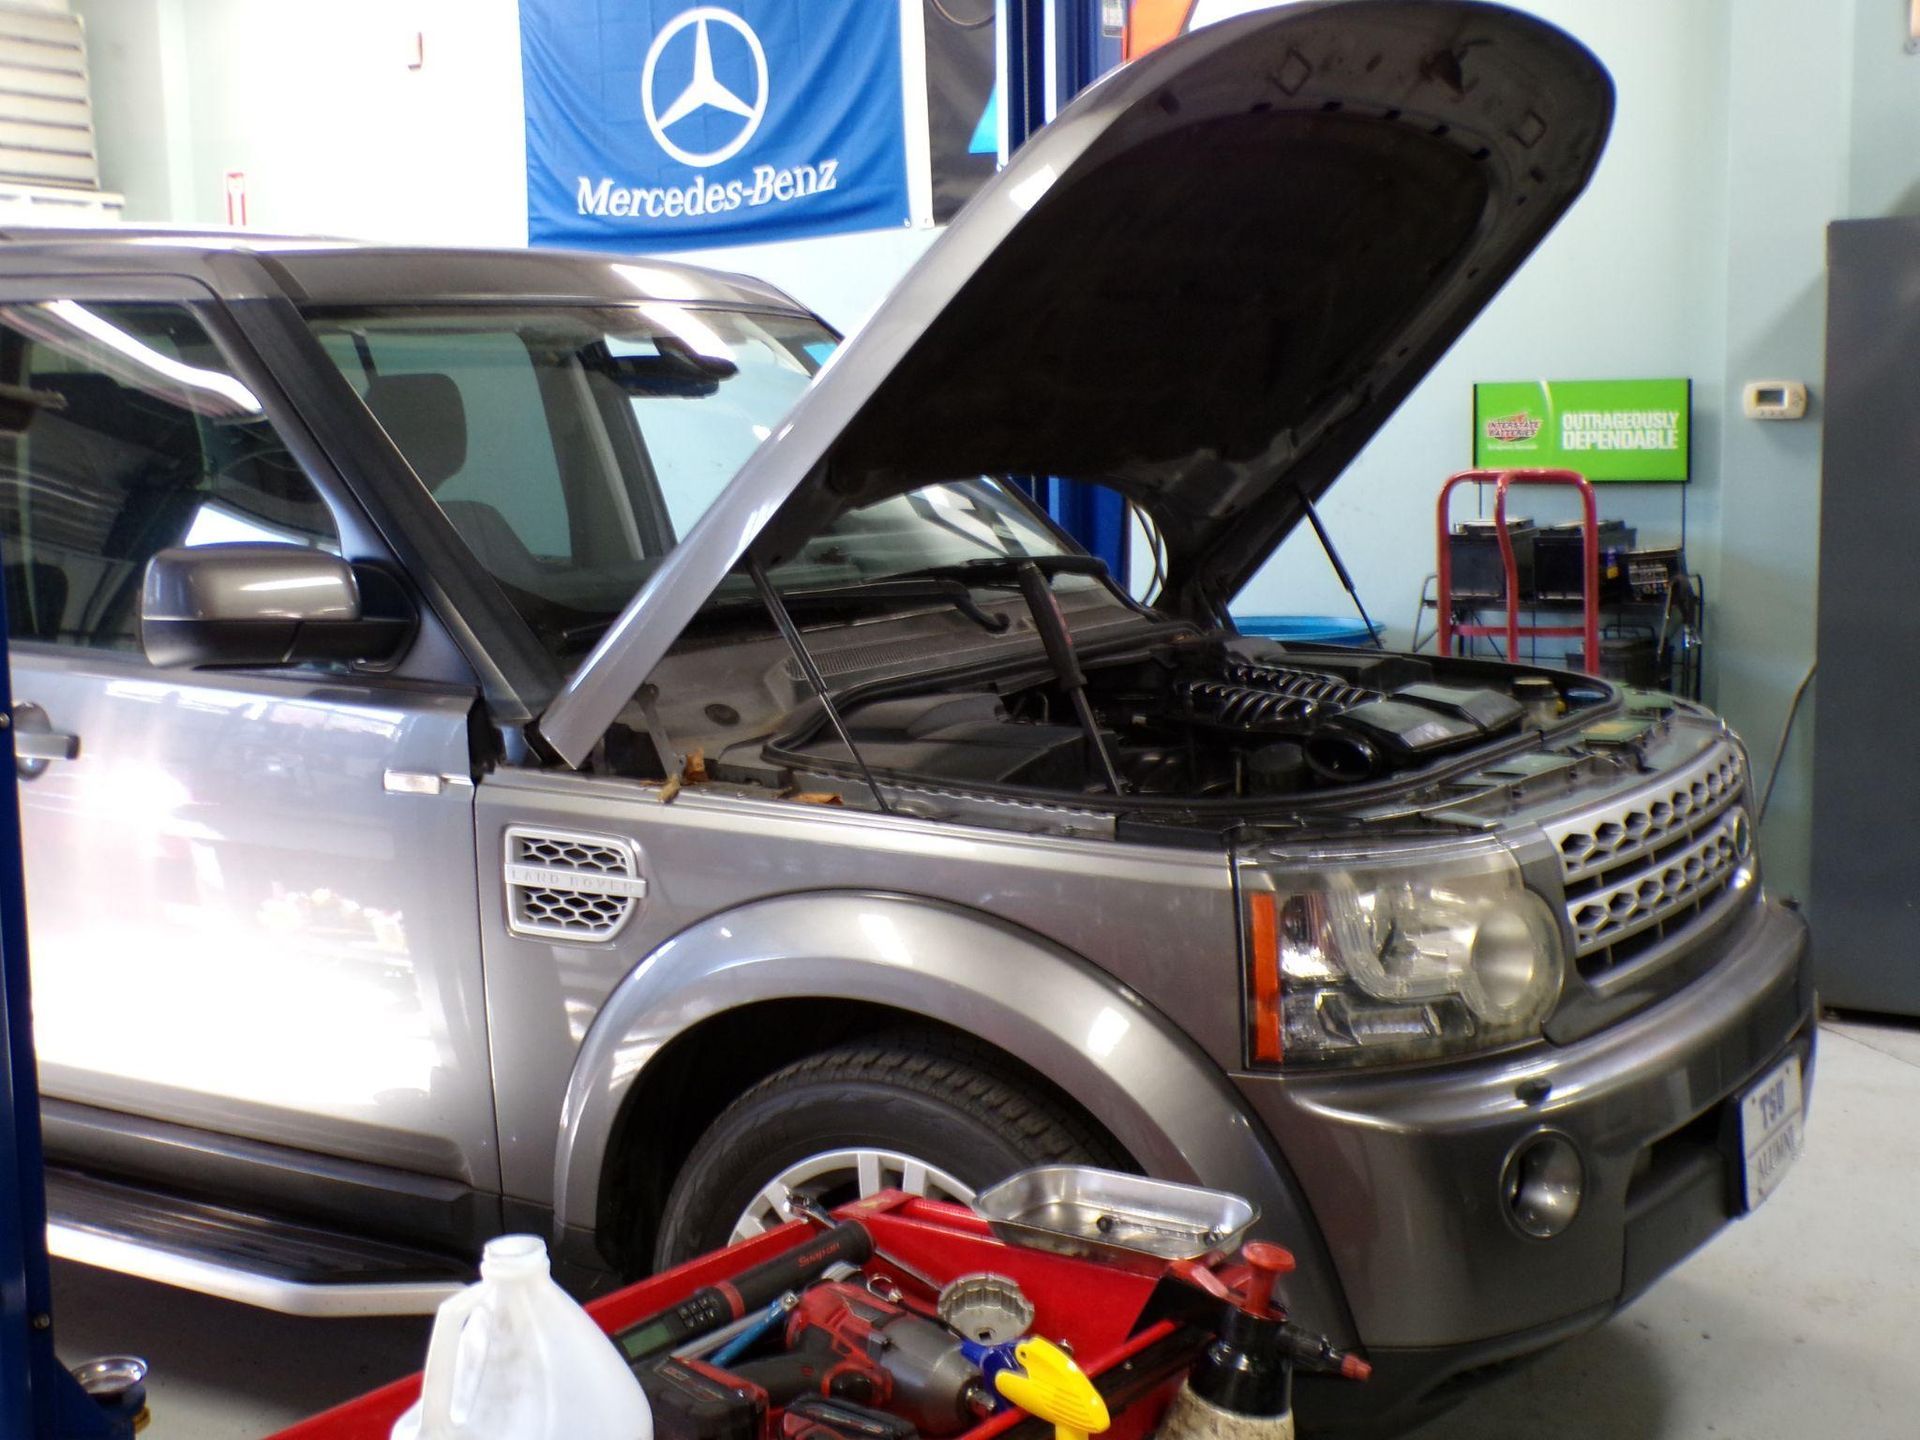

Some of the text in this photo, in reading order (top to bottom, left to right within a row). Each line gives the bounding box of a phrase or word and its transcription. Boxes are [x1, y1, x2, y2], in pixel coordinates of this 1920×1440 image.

[577, 158, 840, 218] Mercedes-Benz
[1562, 412, 1680, 430] OUTRAGEOUSLY
[1562, 429, 1679, 450] DEPENDABLE
